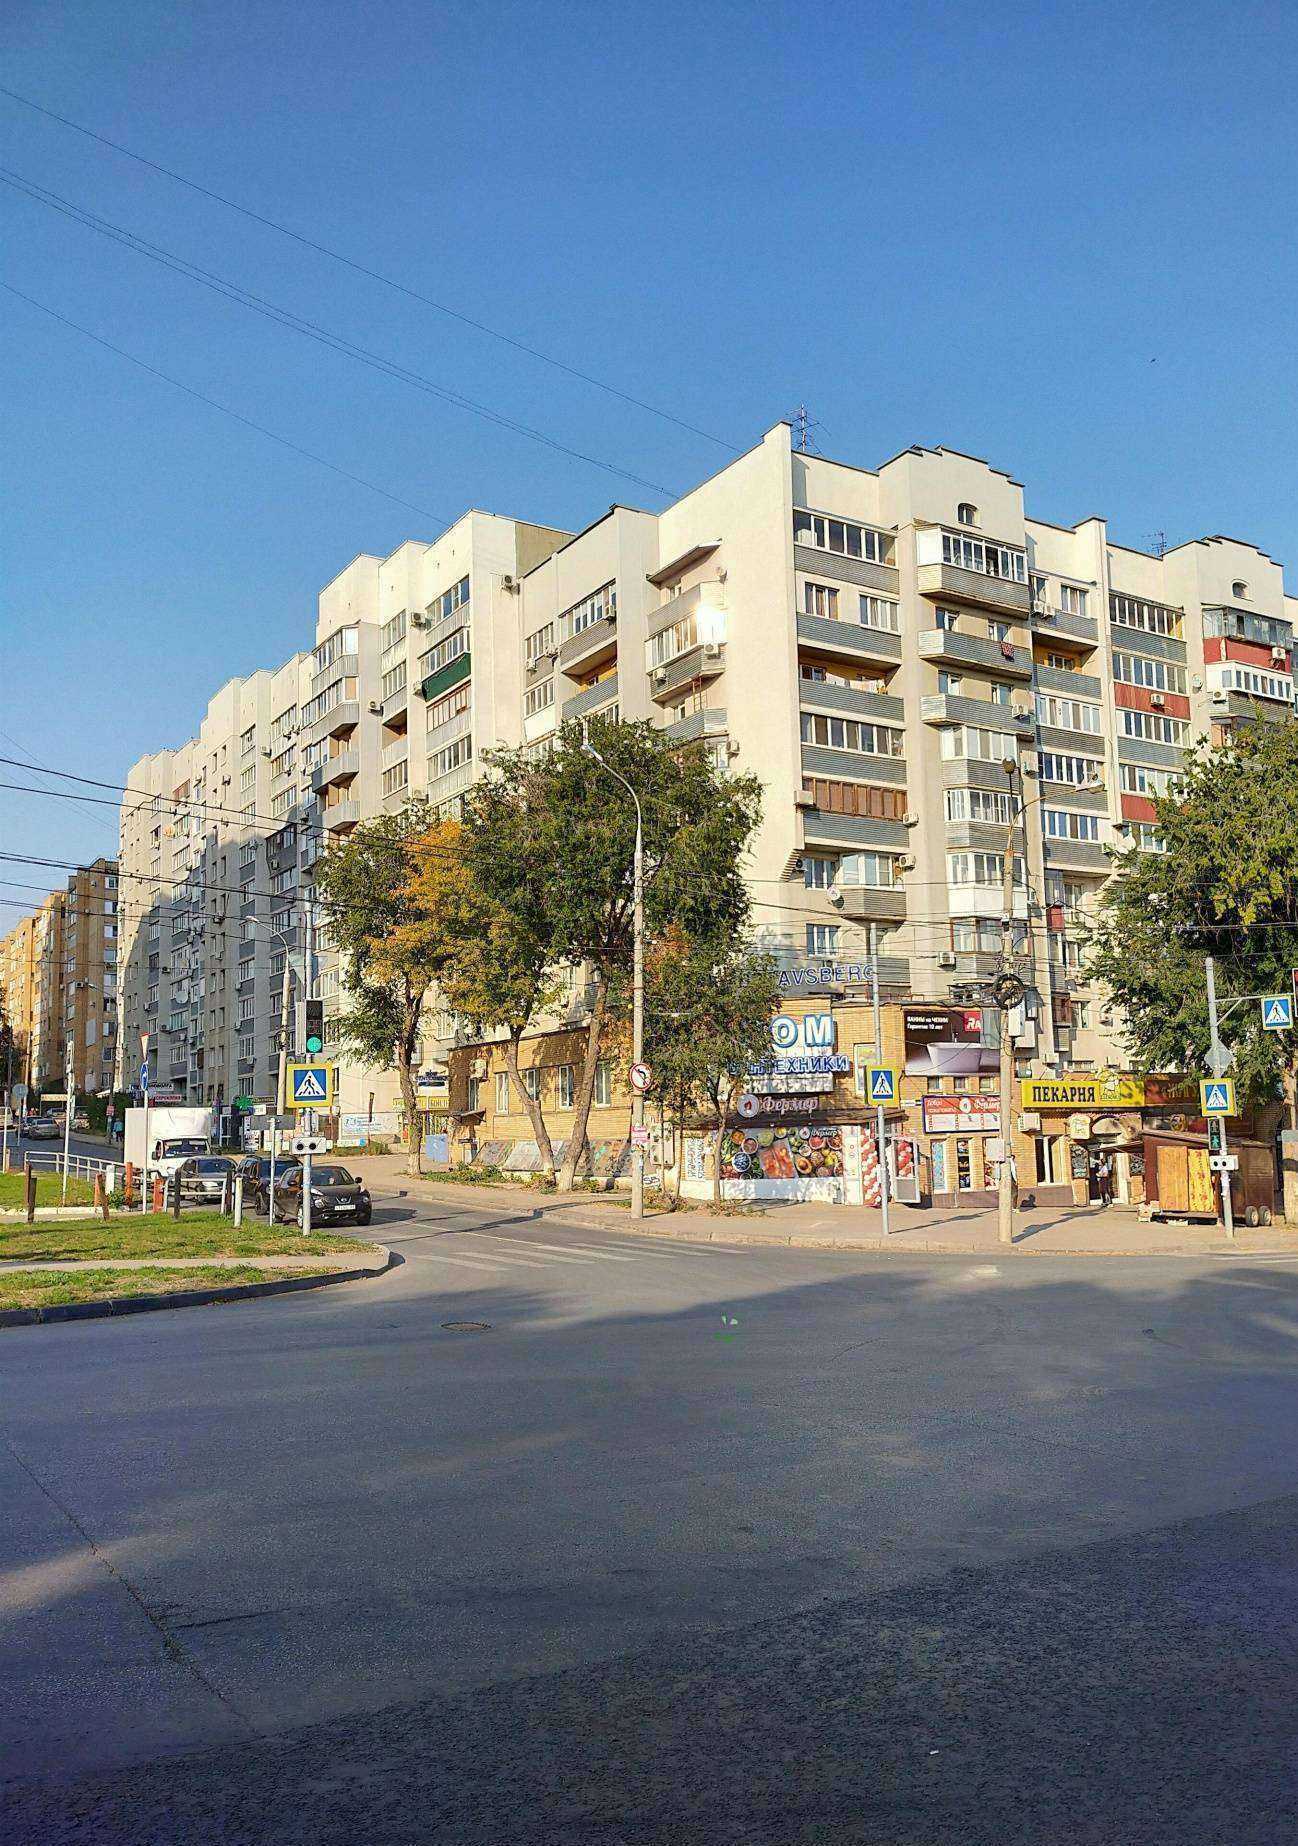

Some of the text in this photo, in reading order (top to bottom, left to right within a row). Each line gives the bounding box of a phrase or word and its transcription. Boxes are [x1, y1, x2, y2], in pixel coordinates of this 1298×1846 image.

[770, 1014, 834, 1048] ОМ
[727, 1054, 850, 1076] НТЕХНИКИ
[1032, 1085, 1096, 1103] ПЕКАРНЯ
[761, 1095, 819, 1115] Фермер
